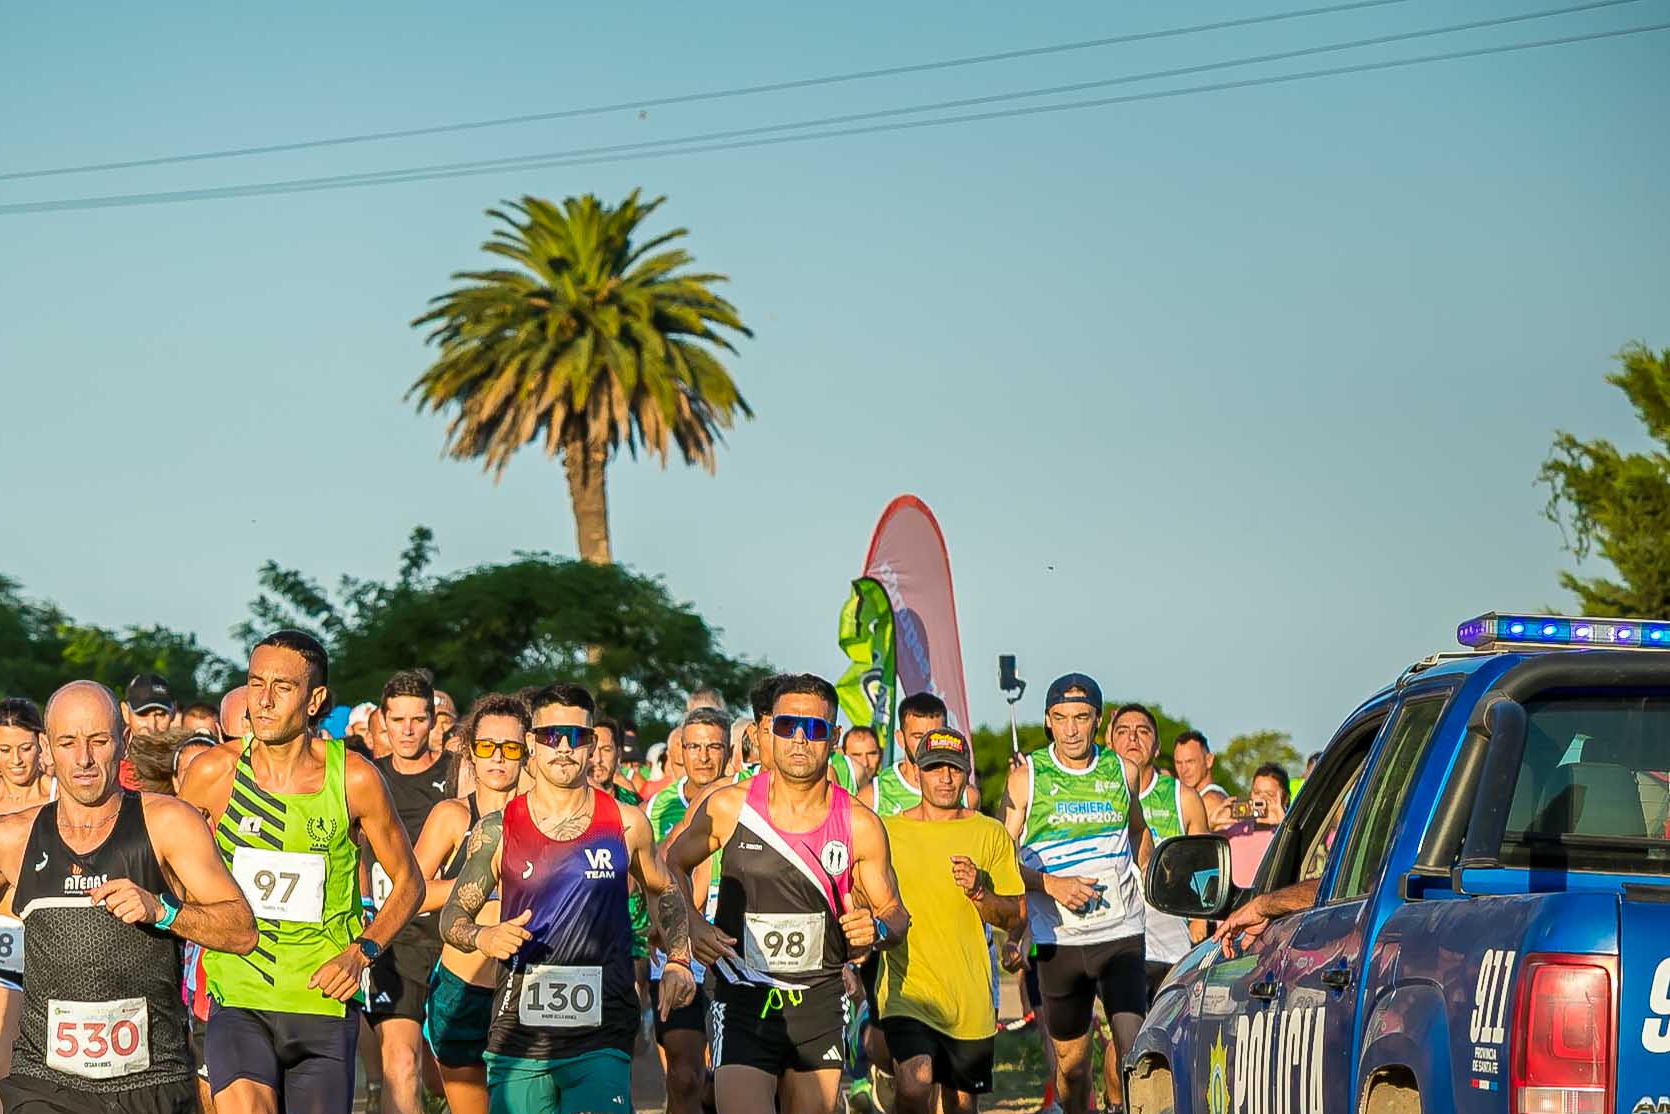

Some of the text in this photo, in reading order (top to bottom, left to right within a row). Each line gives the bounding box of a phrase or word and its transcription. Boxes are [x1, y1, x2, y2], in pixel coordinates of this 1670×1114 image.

[1055, 801, 1113, 814] FIGHIERA
[584, 848, 614, 870] VR
[253, 869, 300, 903] 97
[584, 870, 616, 880] TEAM
[763, 930, 806, 958] 98
[526, 982, 595, 1013] 130
[1469, 948, 1517, 1045] 911
[55, 1019, 139, 1059] 530
